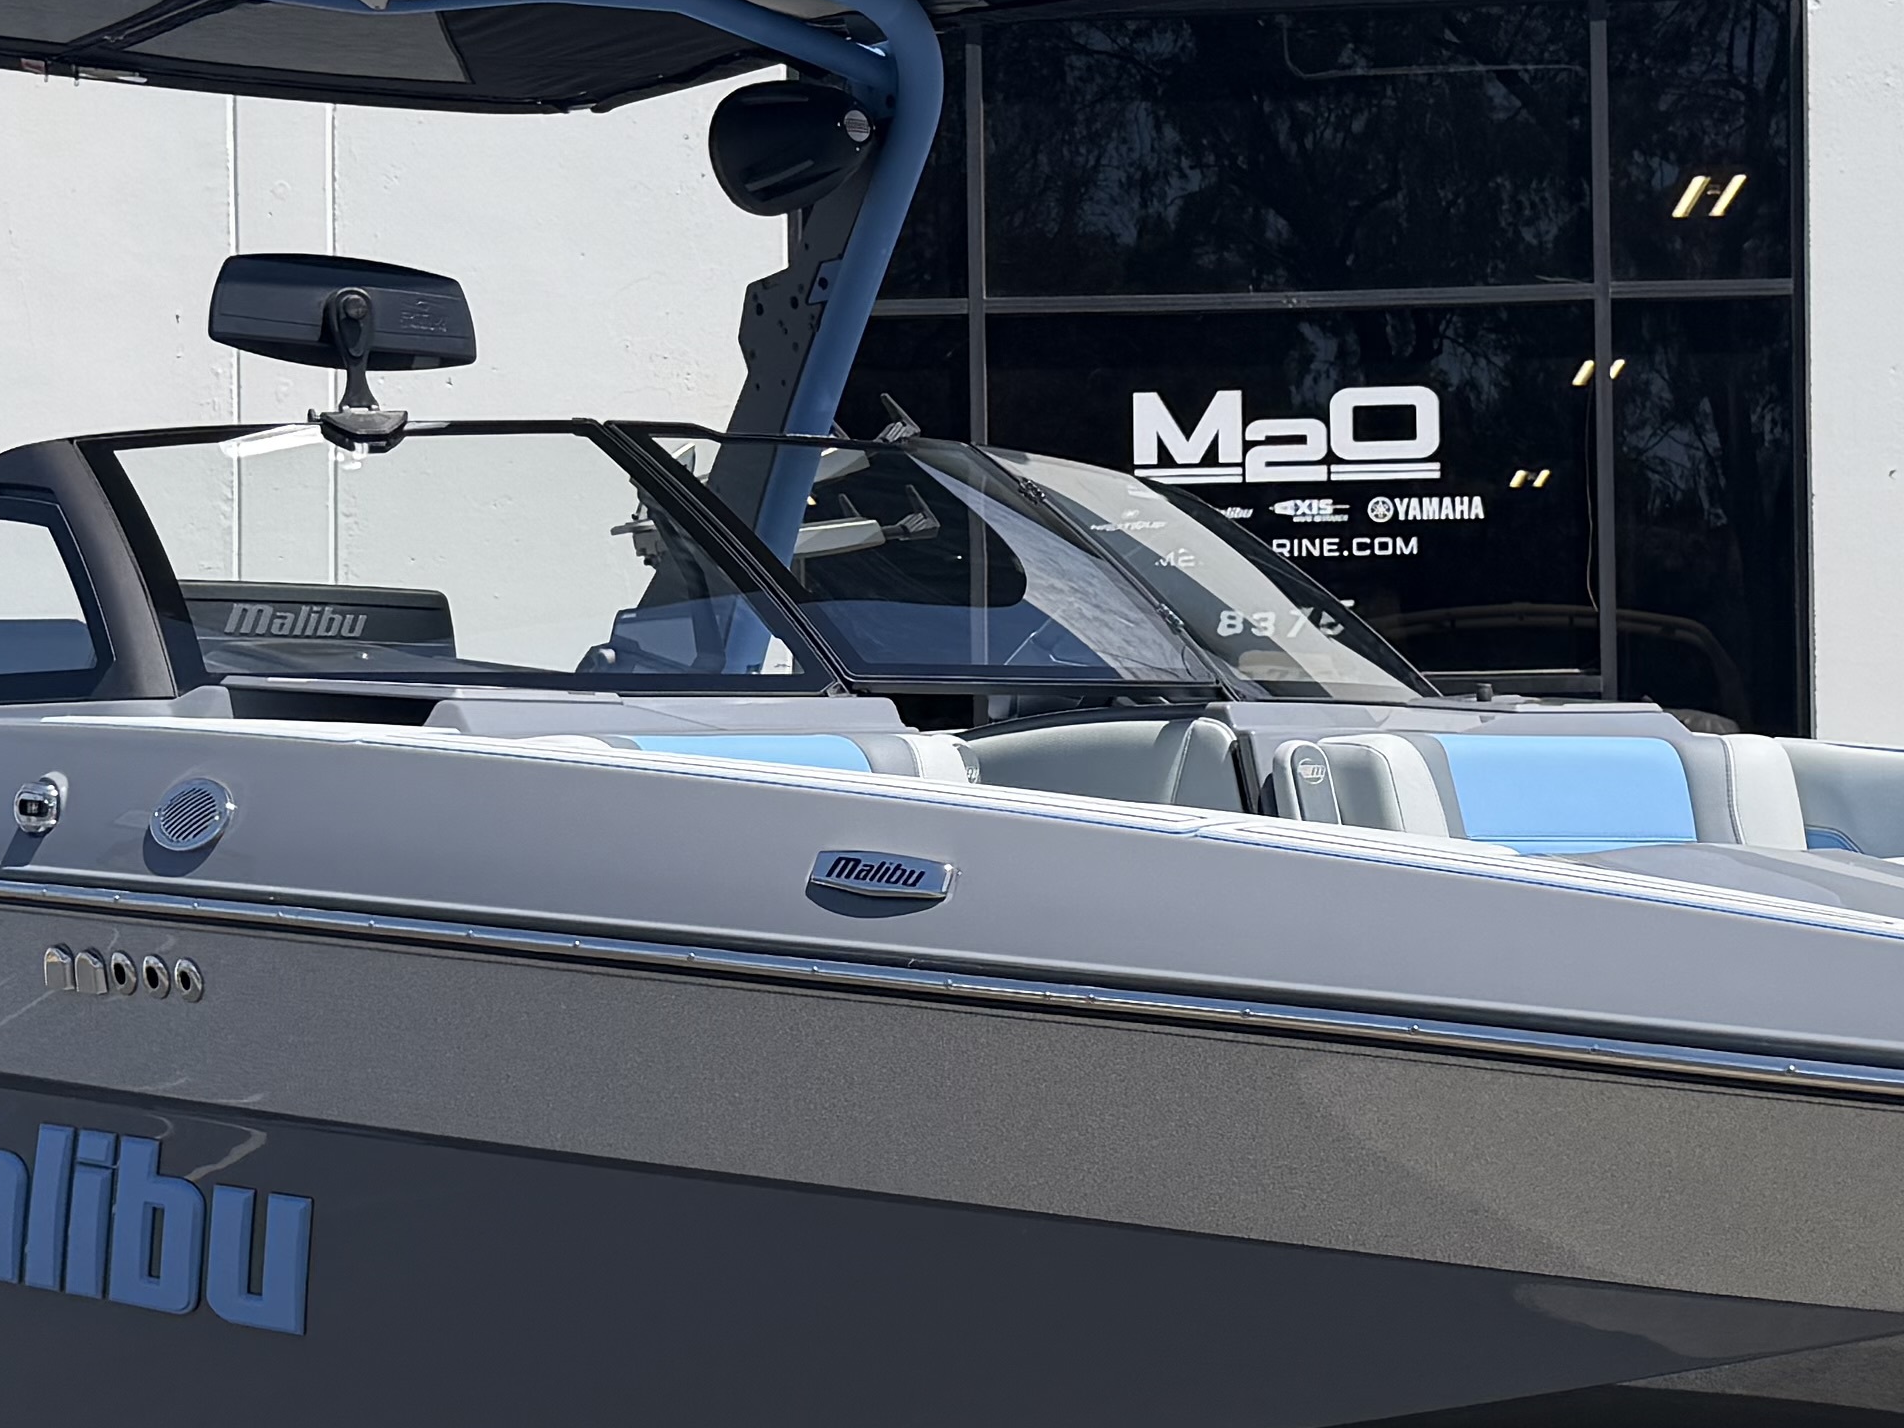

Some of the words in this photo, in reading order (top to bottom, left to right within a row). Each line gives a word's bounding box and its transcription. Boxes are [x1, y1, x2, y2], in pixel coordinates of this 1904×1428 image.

[1392, 495, 1485, 521] YAMAHA
[223, 601, 367, 640] Malibu
[824, 855, 926, 888] Malibu
